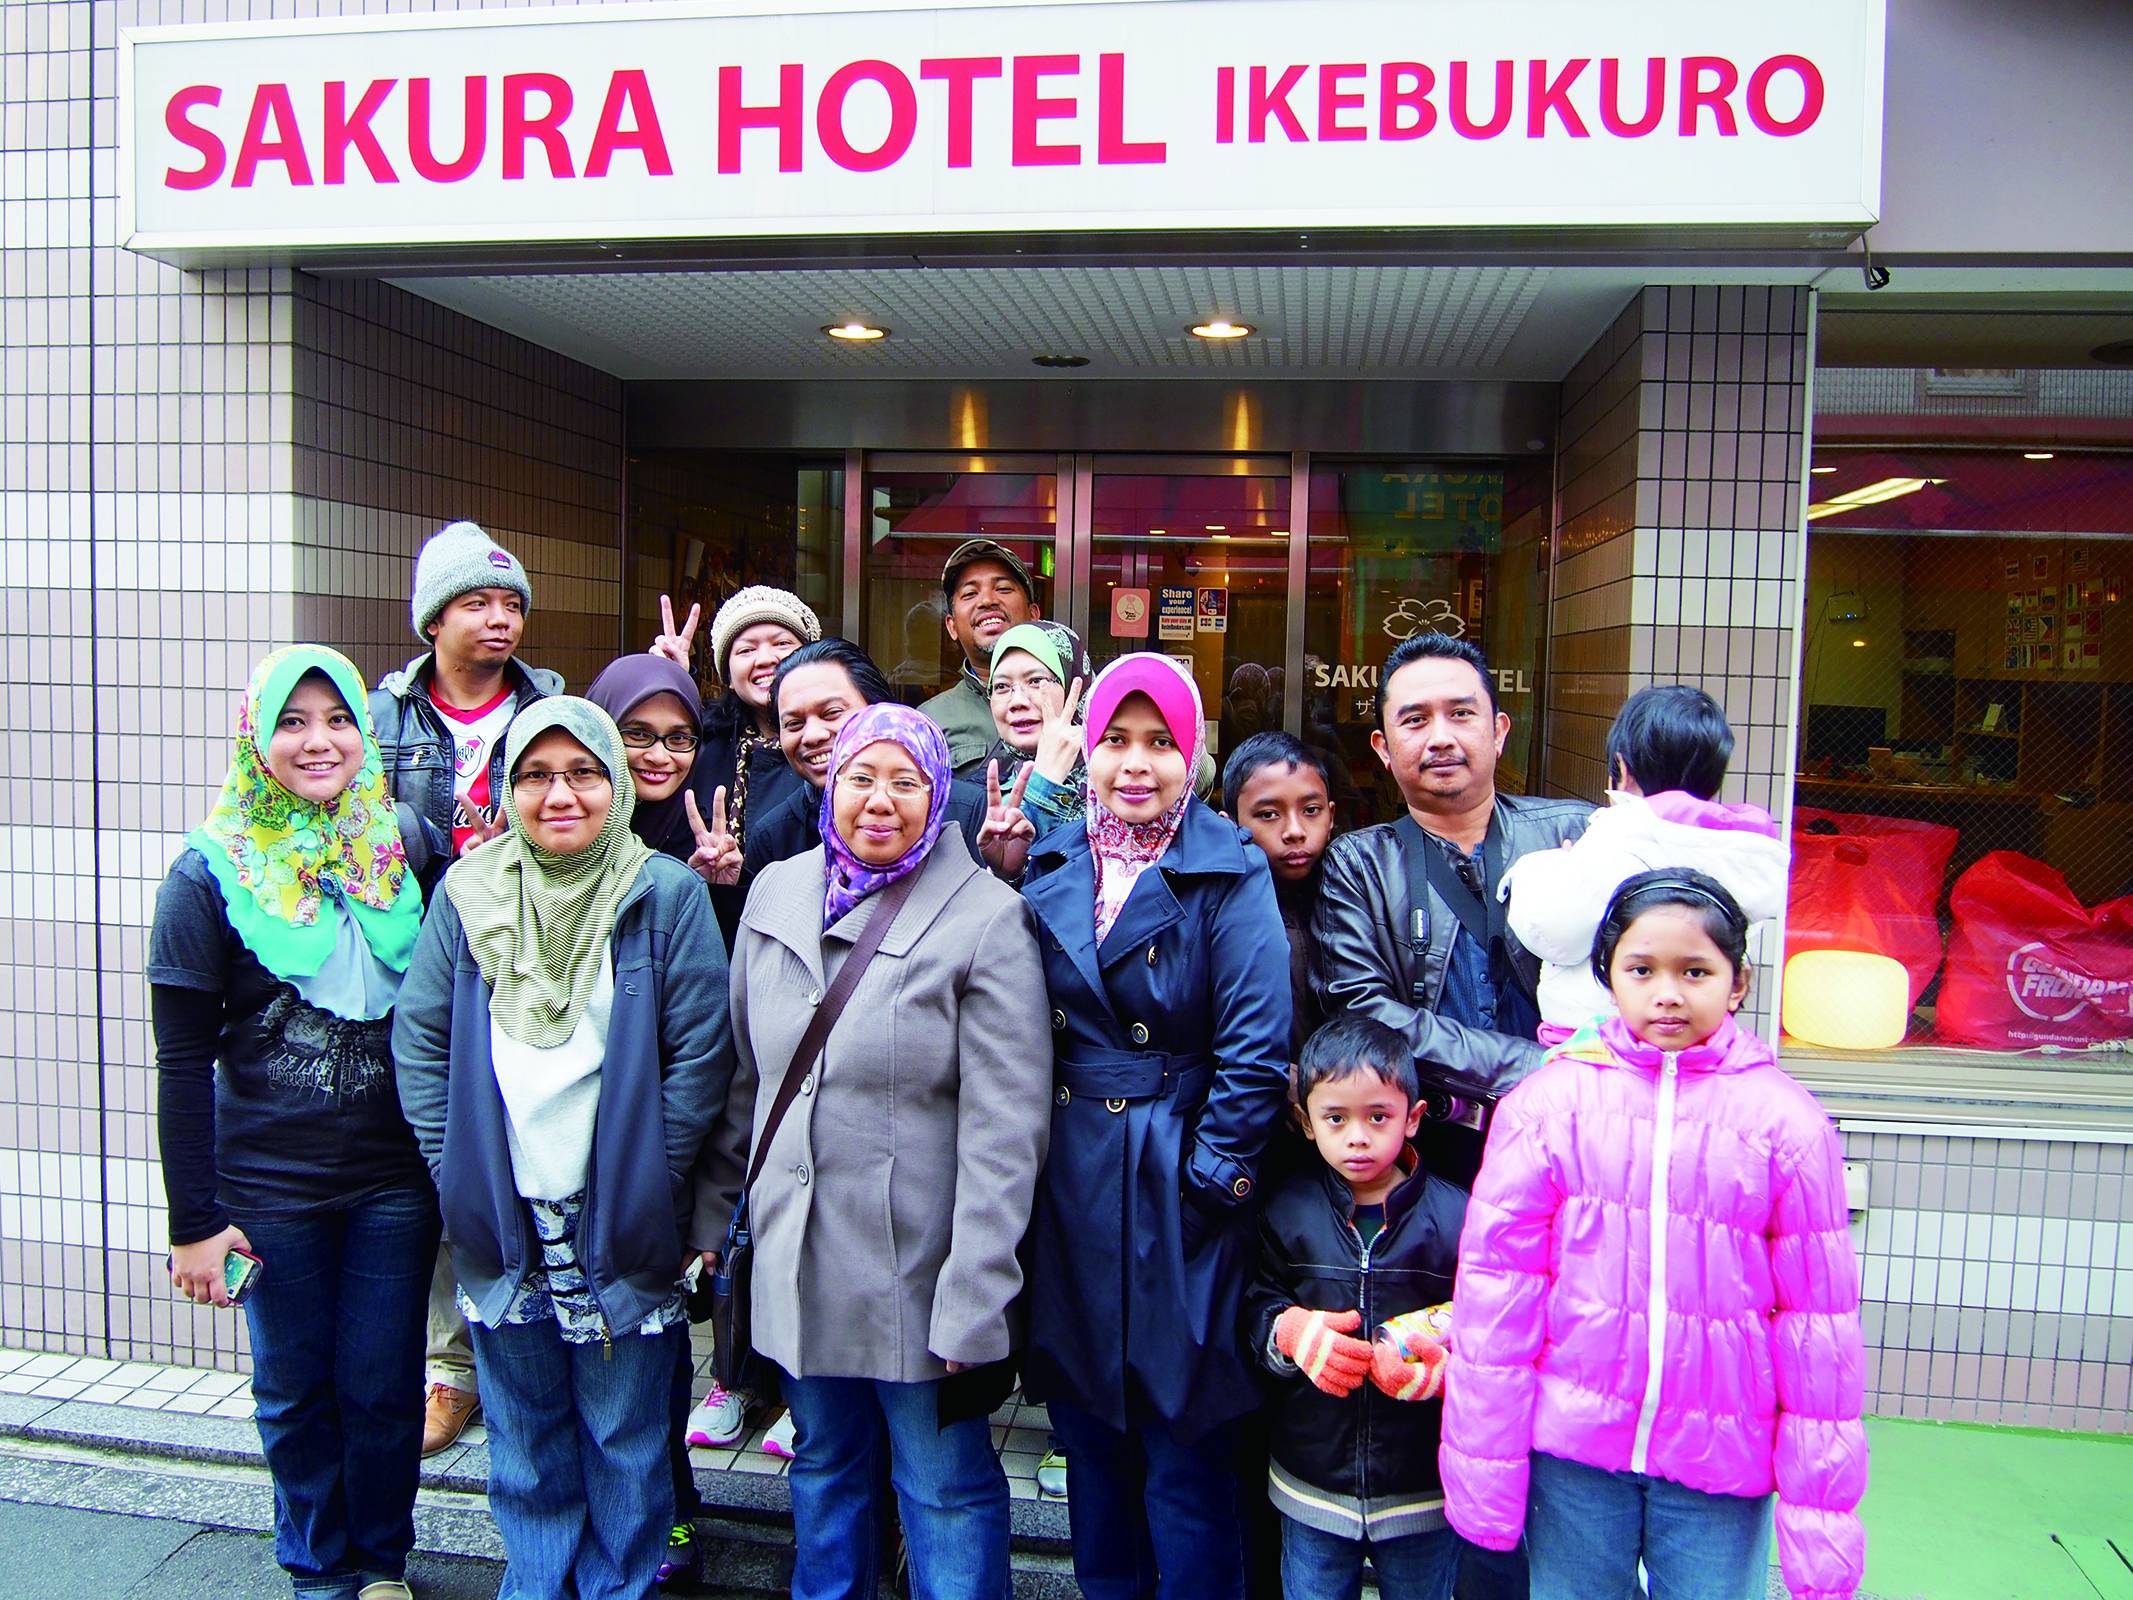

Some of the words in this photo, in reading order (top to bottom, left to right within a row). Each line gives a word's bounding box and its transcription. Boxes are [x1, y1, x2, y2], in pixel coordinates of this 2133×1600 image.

[165, 70, 671, 188] SAKURA
[717, 53, 1167, 173] HOTEL
[1217, 54, 1825, 141] IKEBUKURO
[1162, 588, 1192, 598] Share
[1162, 605, 1192, 614] experience!
